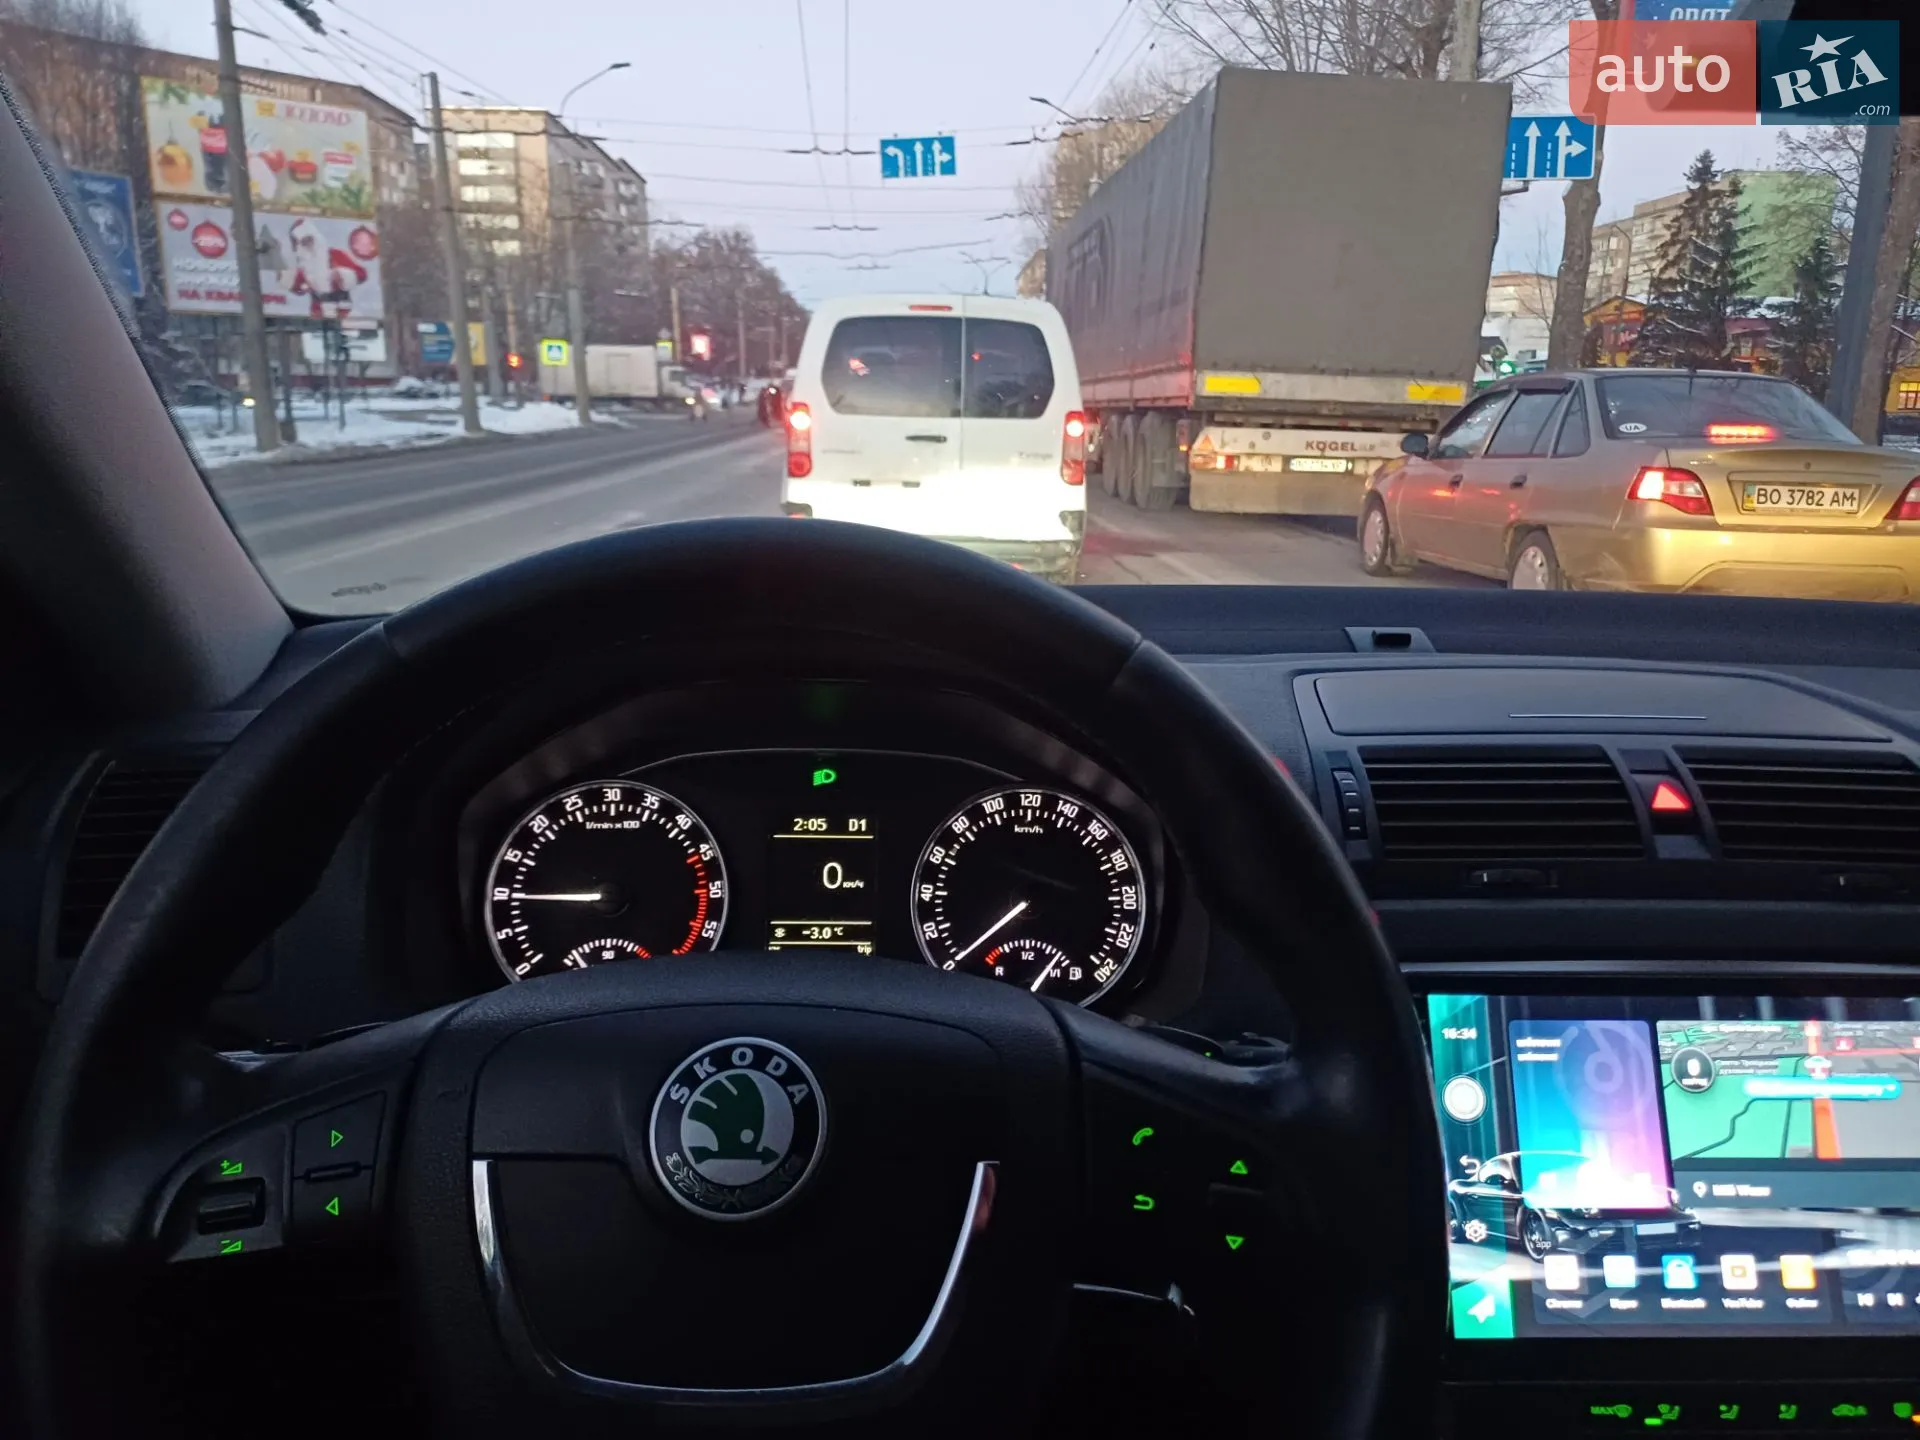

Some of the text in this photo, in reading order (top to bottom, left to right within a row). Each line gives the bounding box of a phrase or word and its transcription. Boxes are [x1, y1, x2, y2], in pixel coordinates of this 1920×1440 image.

[1756, 488, 1856, 507] BO 3782 AM
[562, 794, 583, 812] 25
[603, 788, 621, 802] 30
[640, 793, 660, 810] 35
[1020, 794, 1042, 807] 120
[982, 797, 1005, 815] 100
[1057, 801, 1079, 819] 140
[528, 814, 550, 834] 20
[674, 813, 693, 830] 40
[793, 818, 867, 832] 2:05 D1
[951, 816, 970, 834] 80
[1014, 824, 1044, 834] km/h
[1086, 819, 1109, 842] 160
[503, 848, 523, 864] 15
[698, 842, 715, 862] 45
[929, 845, 946, 865] 60
[1110, 848, 1129, 872] 180
[823, 862, 842, 889] 0
[493, 887, 510, 902] 10
[708, 880, 722, 898] 50
[920, 884, 934, 902] 40
[1121, 885, 1137, 910] 200
[496, 927, 514, 940] 5
[701, 919, 718, 939] 55
[802, 927, 832, 939] -3.0
[923, 922, 939, 940] 20
[1115, 922, 1135, 949] 220
[601, 950, 616, 960] 90
[857, 945, 873, 956] trip
[1021, 951, 1035, 961] 1/2
[514, 963, 531, 976] 0
[943, 960, 956, 971] 0
[995, 966, 1004, 977] R
[1093, 958, 1118, 983] 240
[1536, 1241, 1552, 1250] app
